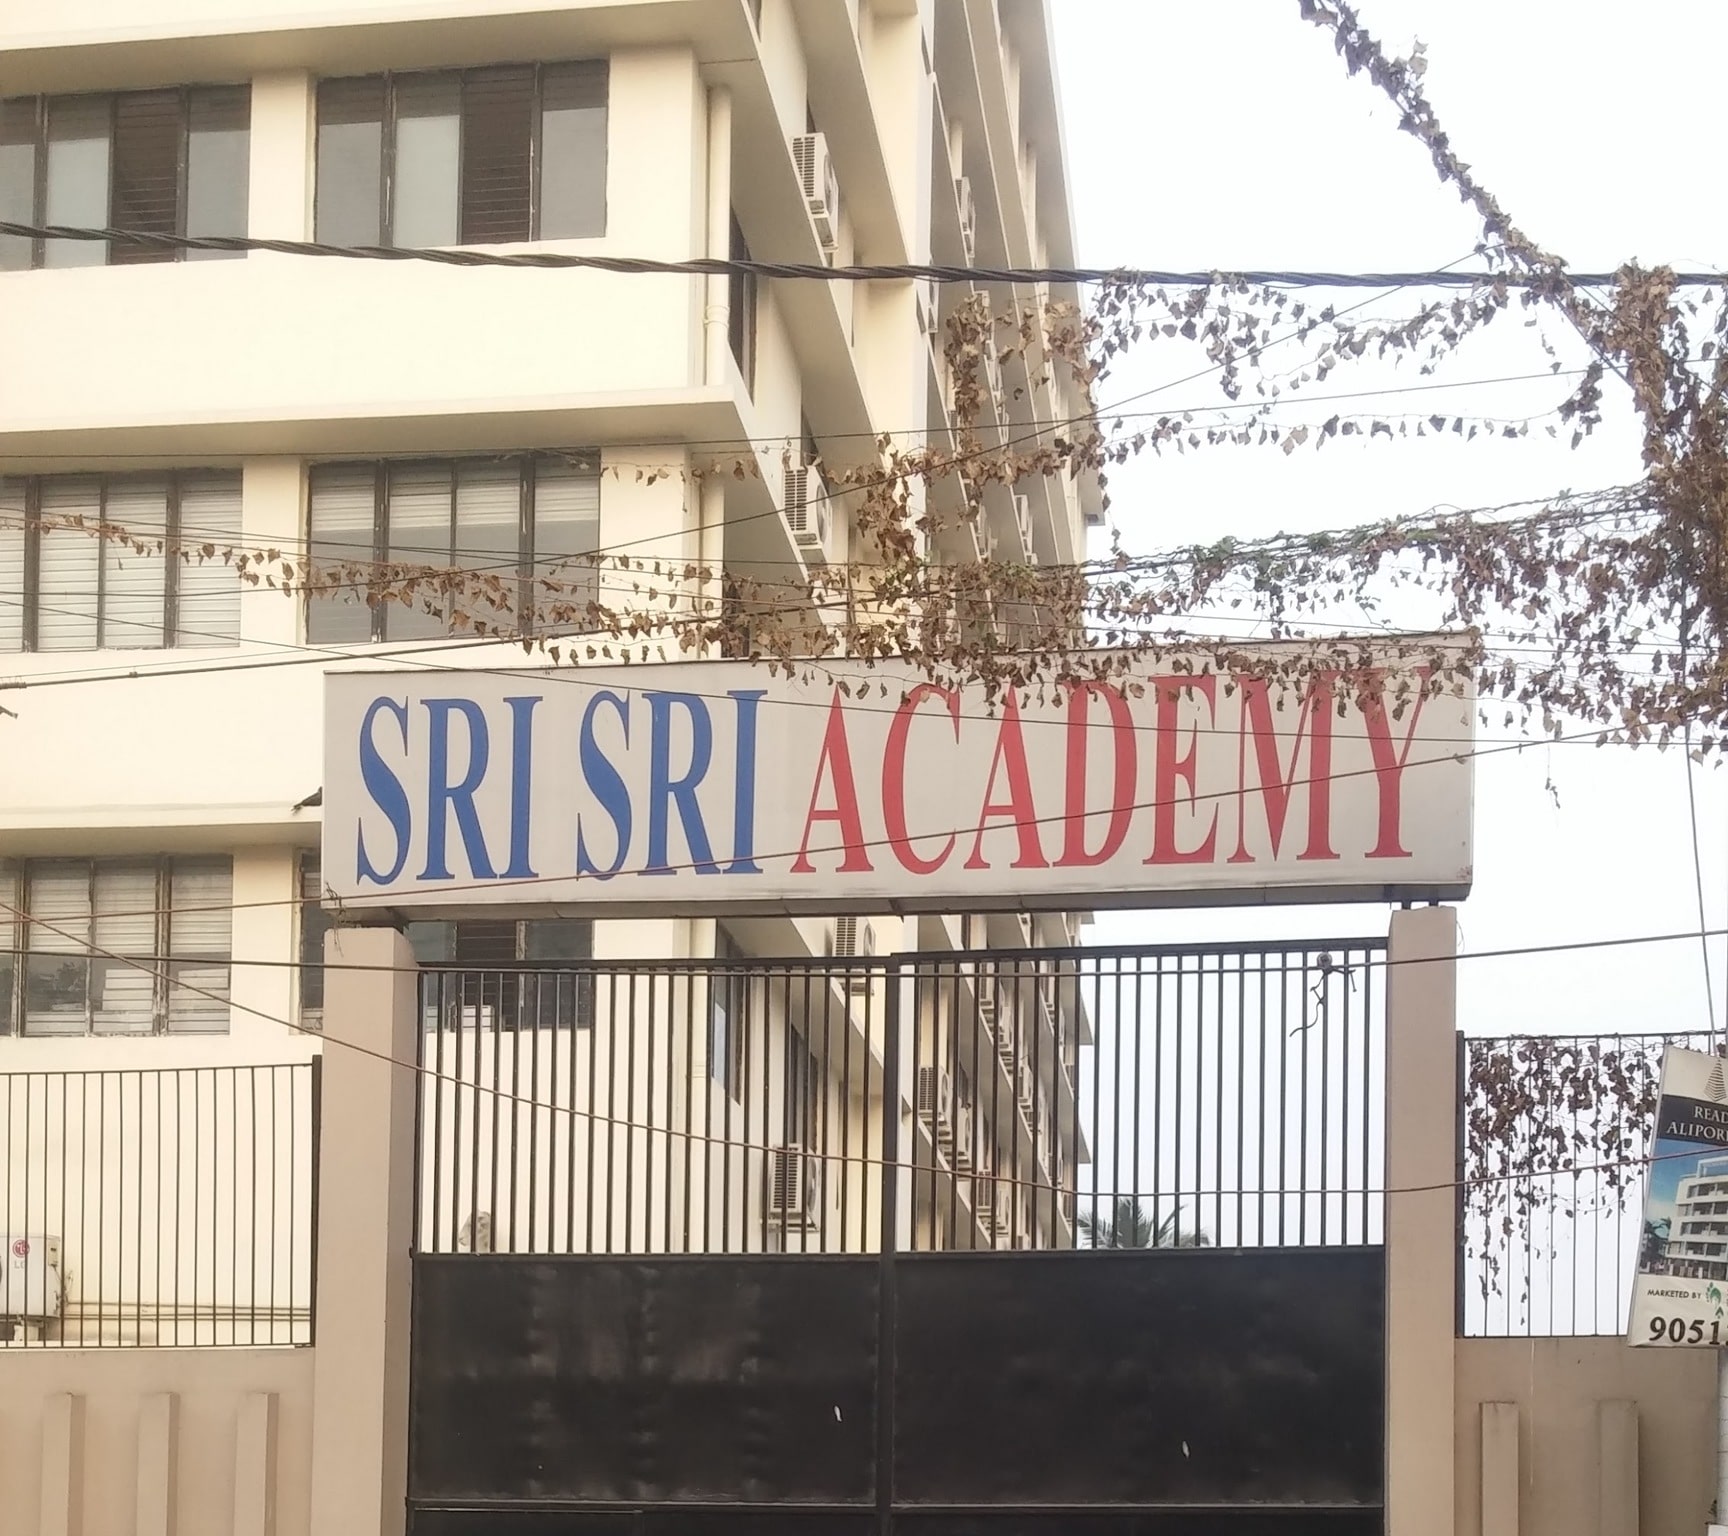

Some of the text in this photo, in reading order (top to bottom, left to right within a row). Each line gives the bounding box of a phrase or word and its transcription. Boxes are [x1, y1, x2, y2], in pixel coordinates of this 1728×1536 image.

[356, 666, 1434, 886] SRI SRI ACADEMY
[1647, 1289, 1689, 1299] MARKETED
[1648, 1316, 1728, 1346] 9051
